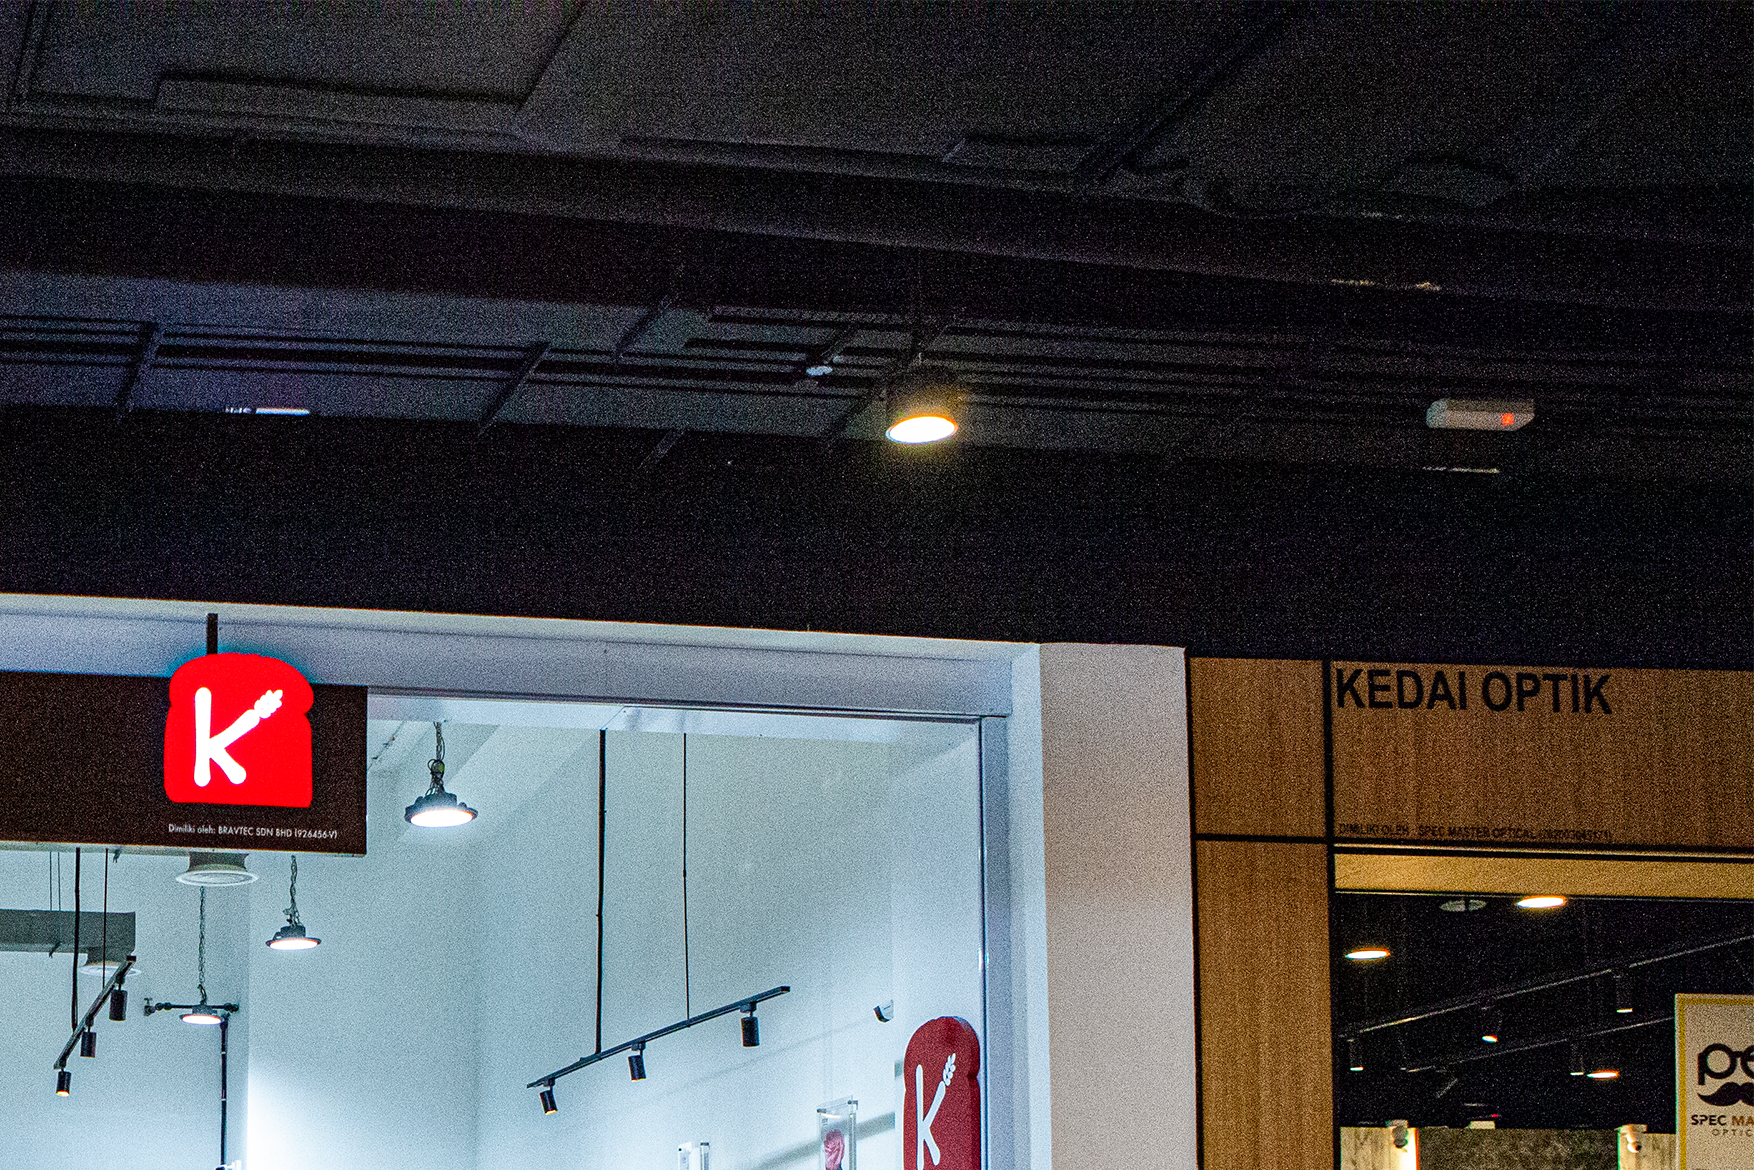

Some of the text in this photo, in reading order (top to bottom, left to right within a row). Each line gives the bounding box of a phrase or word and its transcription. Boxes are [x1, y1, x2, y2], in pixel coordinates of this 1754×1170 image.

[1336, 668, 1613, 715] KEDAI OPTIK
[168, 823, 195, 834] Dimiliki
[197, 825, 216, 835] oleh:
[218, 825, 254, 837] BRAVTEC
[255, 827, 274, 838] SDN
[275, 828, 292, 839] BHD
[1690, 1114, 1727, 1126] SPEC
